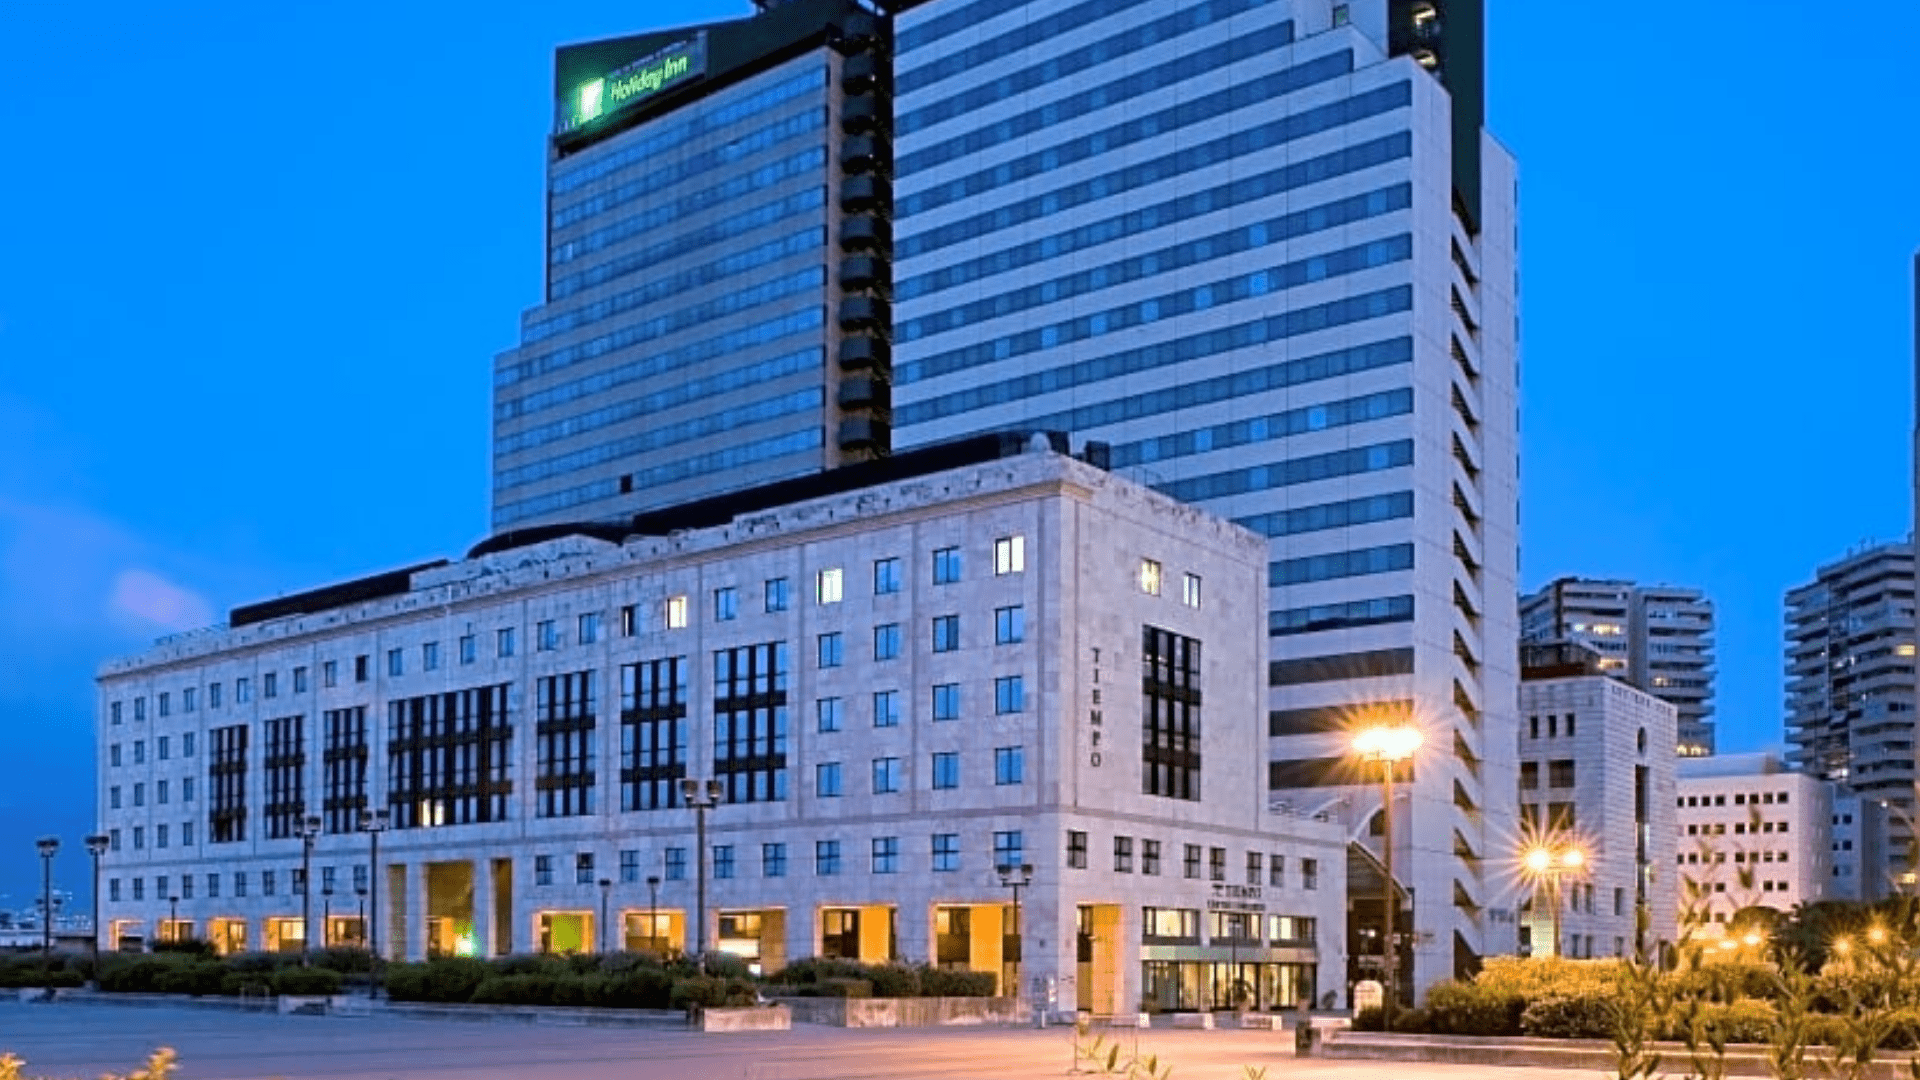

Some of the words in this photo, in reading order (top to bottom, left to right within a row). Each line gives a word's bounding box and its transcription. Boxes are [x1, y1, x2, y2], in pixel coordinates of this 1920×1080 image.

[610, 68, 664, 101] Holiday
[664, 56, 688, 80] Inn
[1090, 646, 1102, 768] TIEMPO
